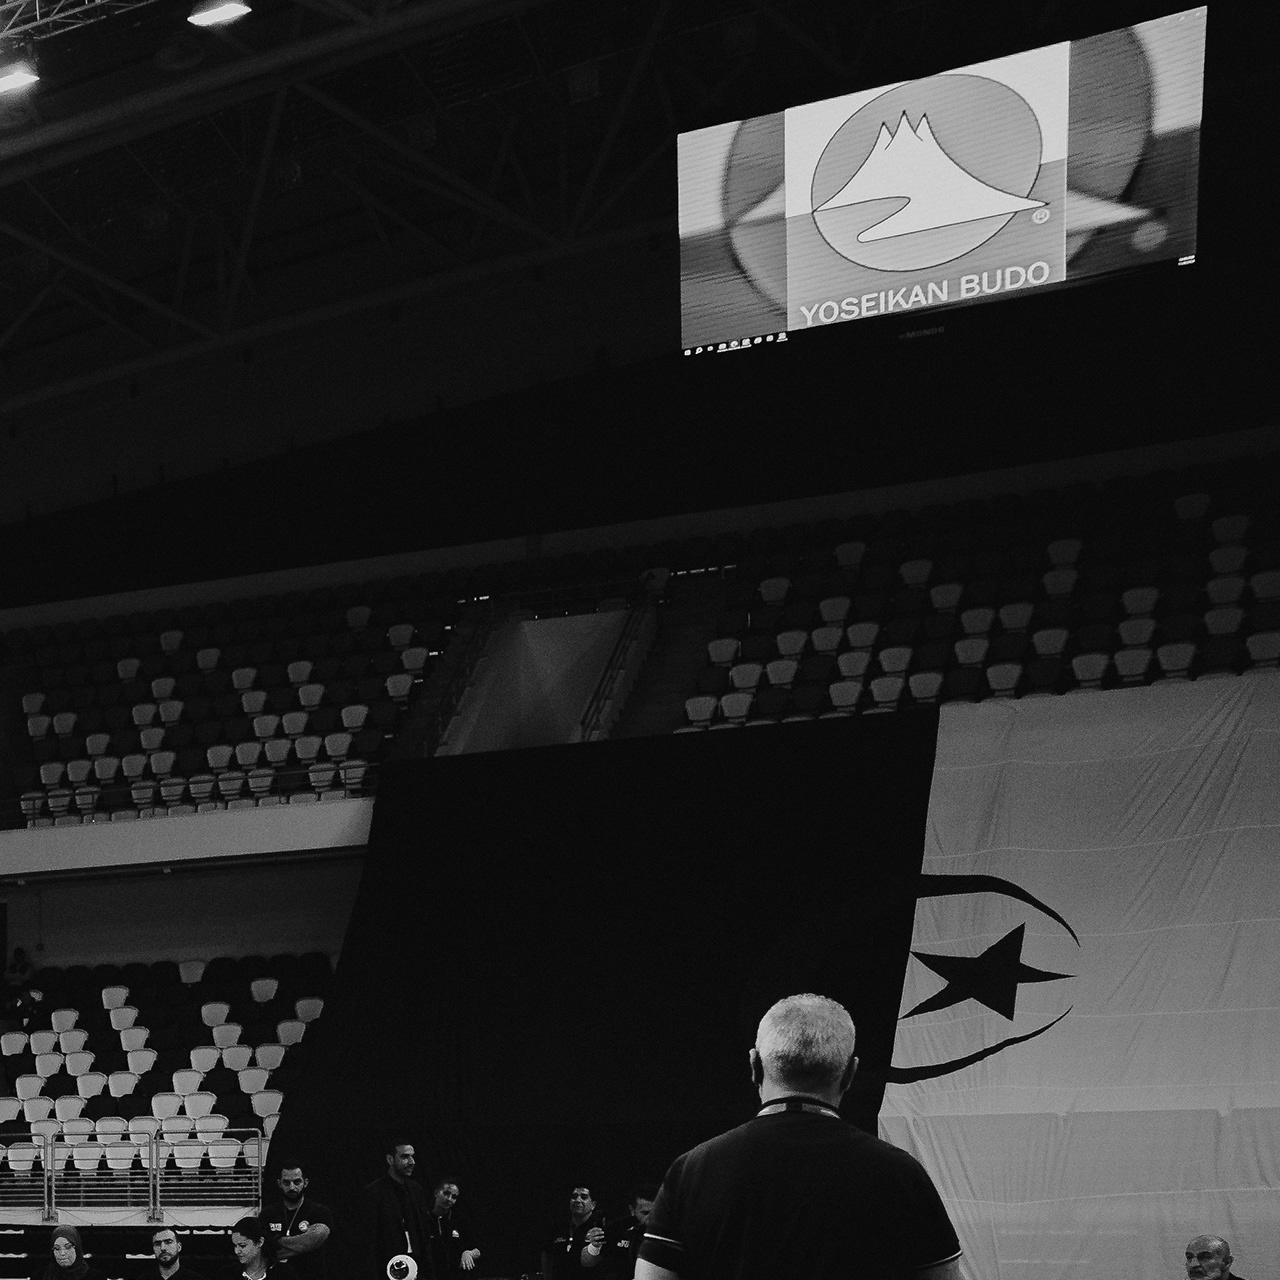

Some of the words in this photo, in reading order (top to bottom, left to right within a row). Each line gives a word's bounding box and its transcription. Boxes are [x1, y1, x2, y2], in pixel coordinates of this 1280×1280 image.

[800, 280, 948, 328] YOSEIKAN
[960, 261, 1050, 299] BUDO
[906, 326, 945, 338] MONDO
